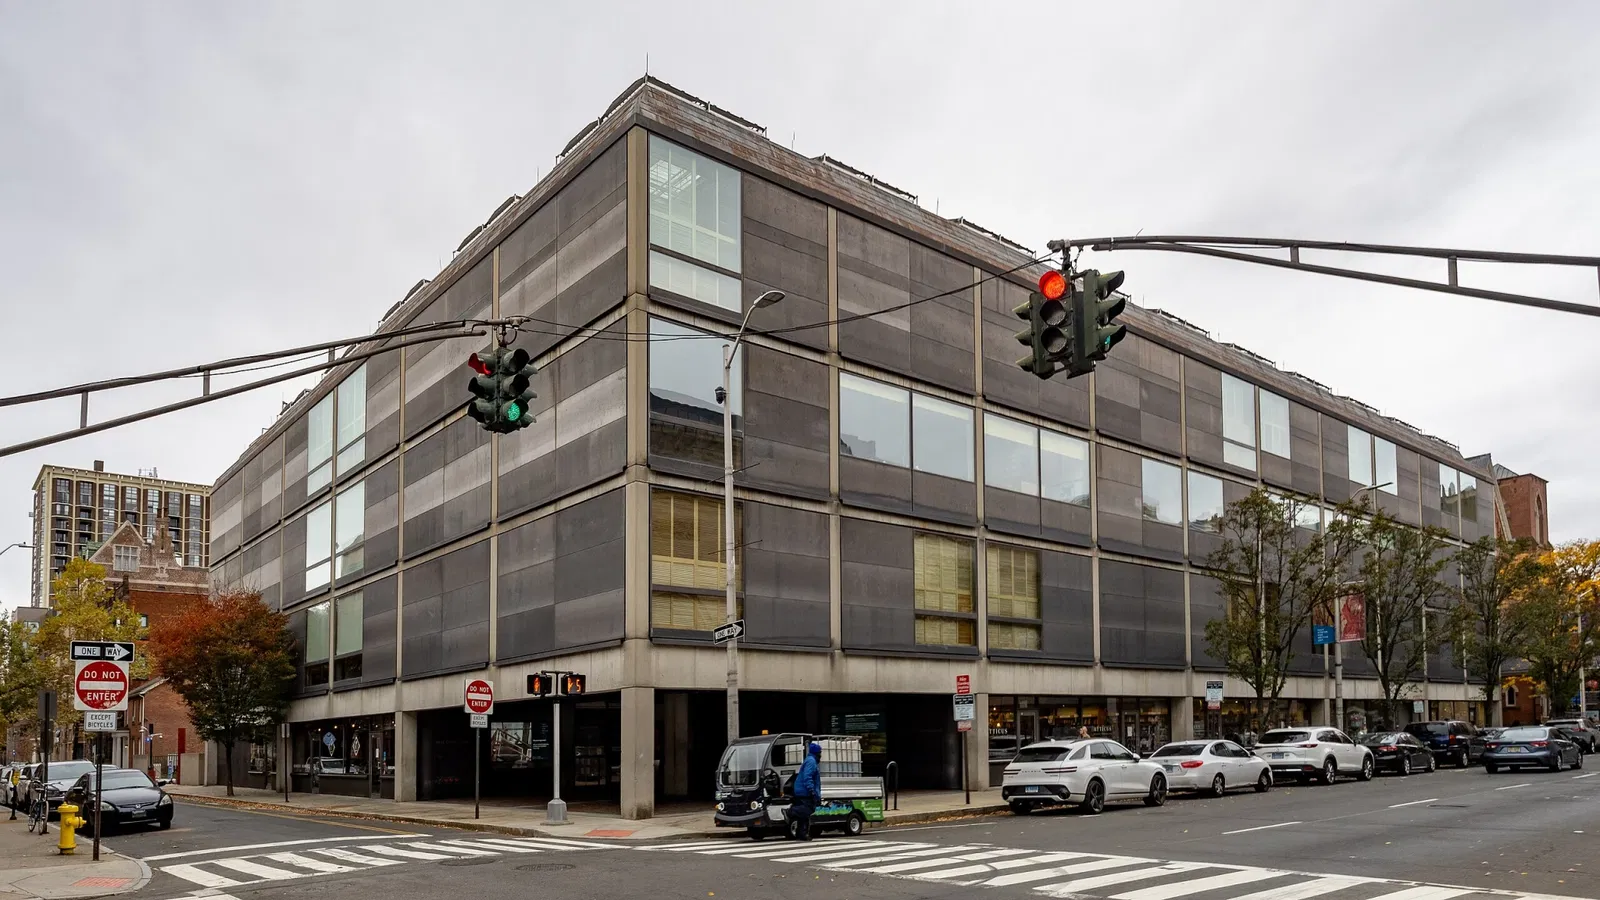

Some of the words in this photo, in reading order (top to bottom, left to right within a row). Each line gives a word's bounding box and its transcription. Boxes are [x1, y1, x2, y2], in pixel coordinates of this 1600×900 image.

[81, 647, 97, 655] ONE
[107, 648, 122, 656] WAY
[84, 670, 97, 679] DO
[102, 671, 121, 679] NOT
[87, 692, 116, 701] ENTER
